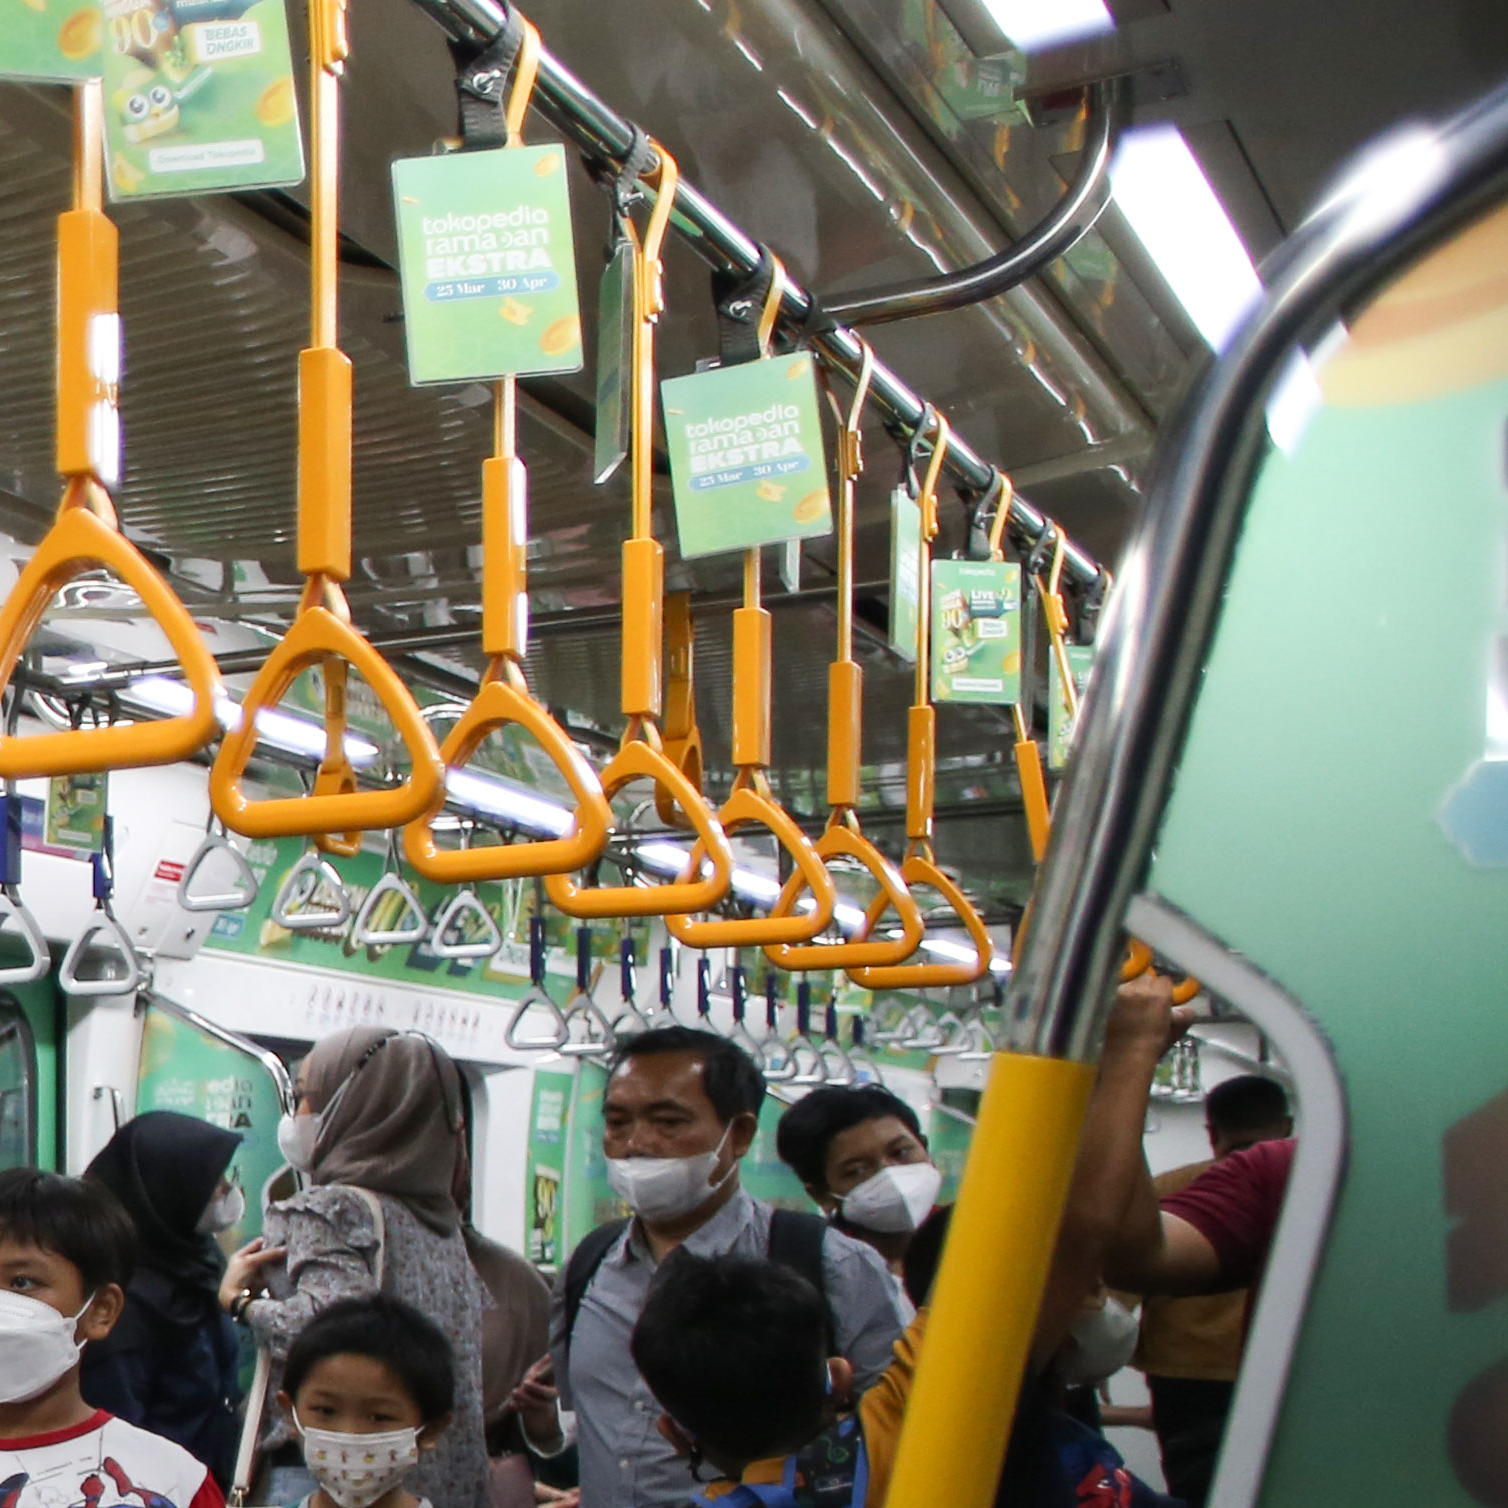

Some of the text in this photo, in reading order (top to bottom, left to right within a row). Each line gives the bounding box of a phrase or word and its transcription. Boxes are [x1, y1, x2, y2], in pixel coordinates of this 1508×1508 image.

[204, 26, 248, 41] BEBAS
[206, 38, 254, 55] ONGKIR
[422, 205, 549, 235] tokopedia
[427, 247, 552, 279] EKSTRA
[436, 277, 548, 298] 25 Mar 30 Apr
[686, 404, 800, 439] tokopedia
[691, 436, 804, 473] EKSTRA
[753, 464, 772, 476] 30
